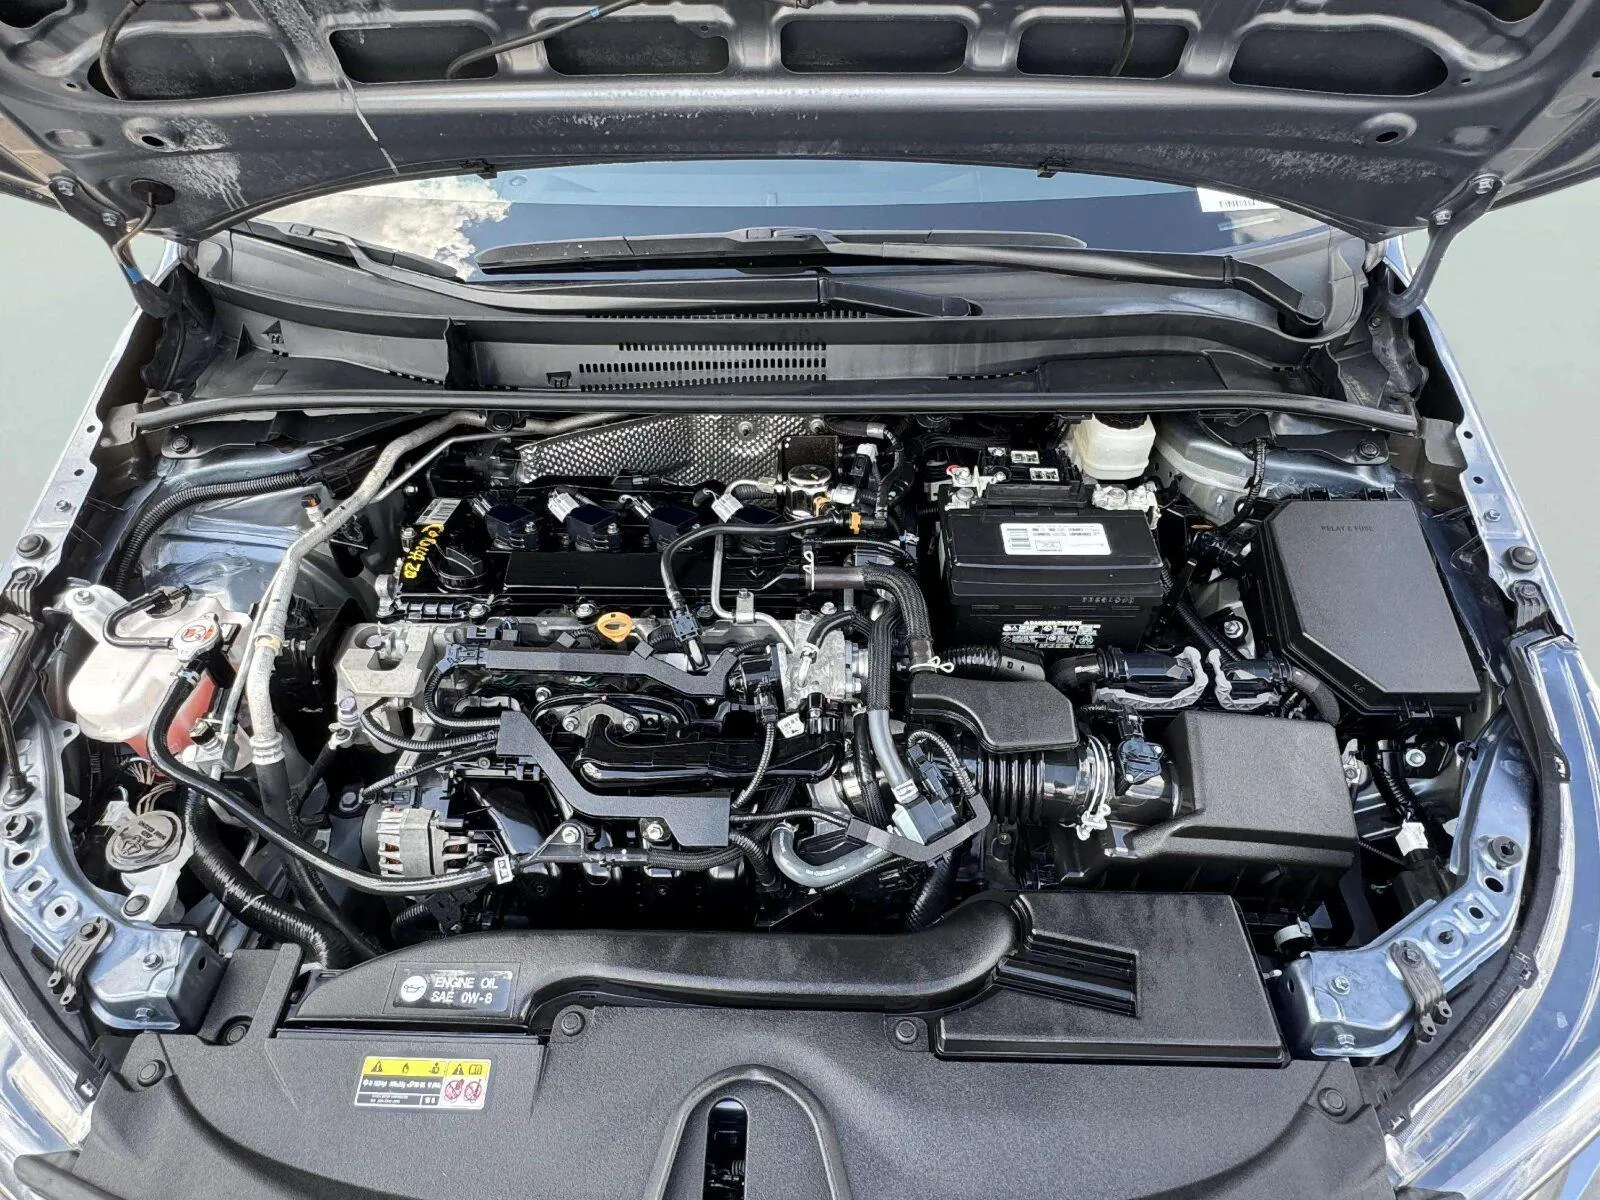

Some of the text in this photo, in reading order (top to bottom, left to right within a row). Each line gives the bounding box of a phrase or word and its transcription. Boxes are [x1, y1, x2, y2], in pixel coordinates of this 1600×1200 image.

[434, 976, 499, 989] ENGINE OIL
[430, 991, 455, 1003] SAE
